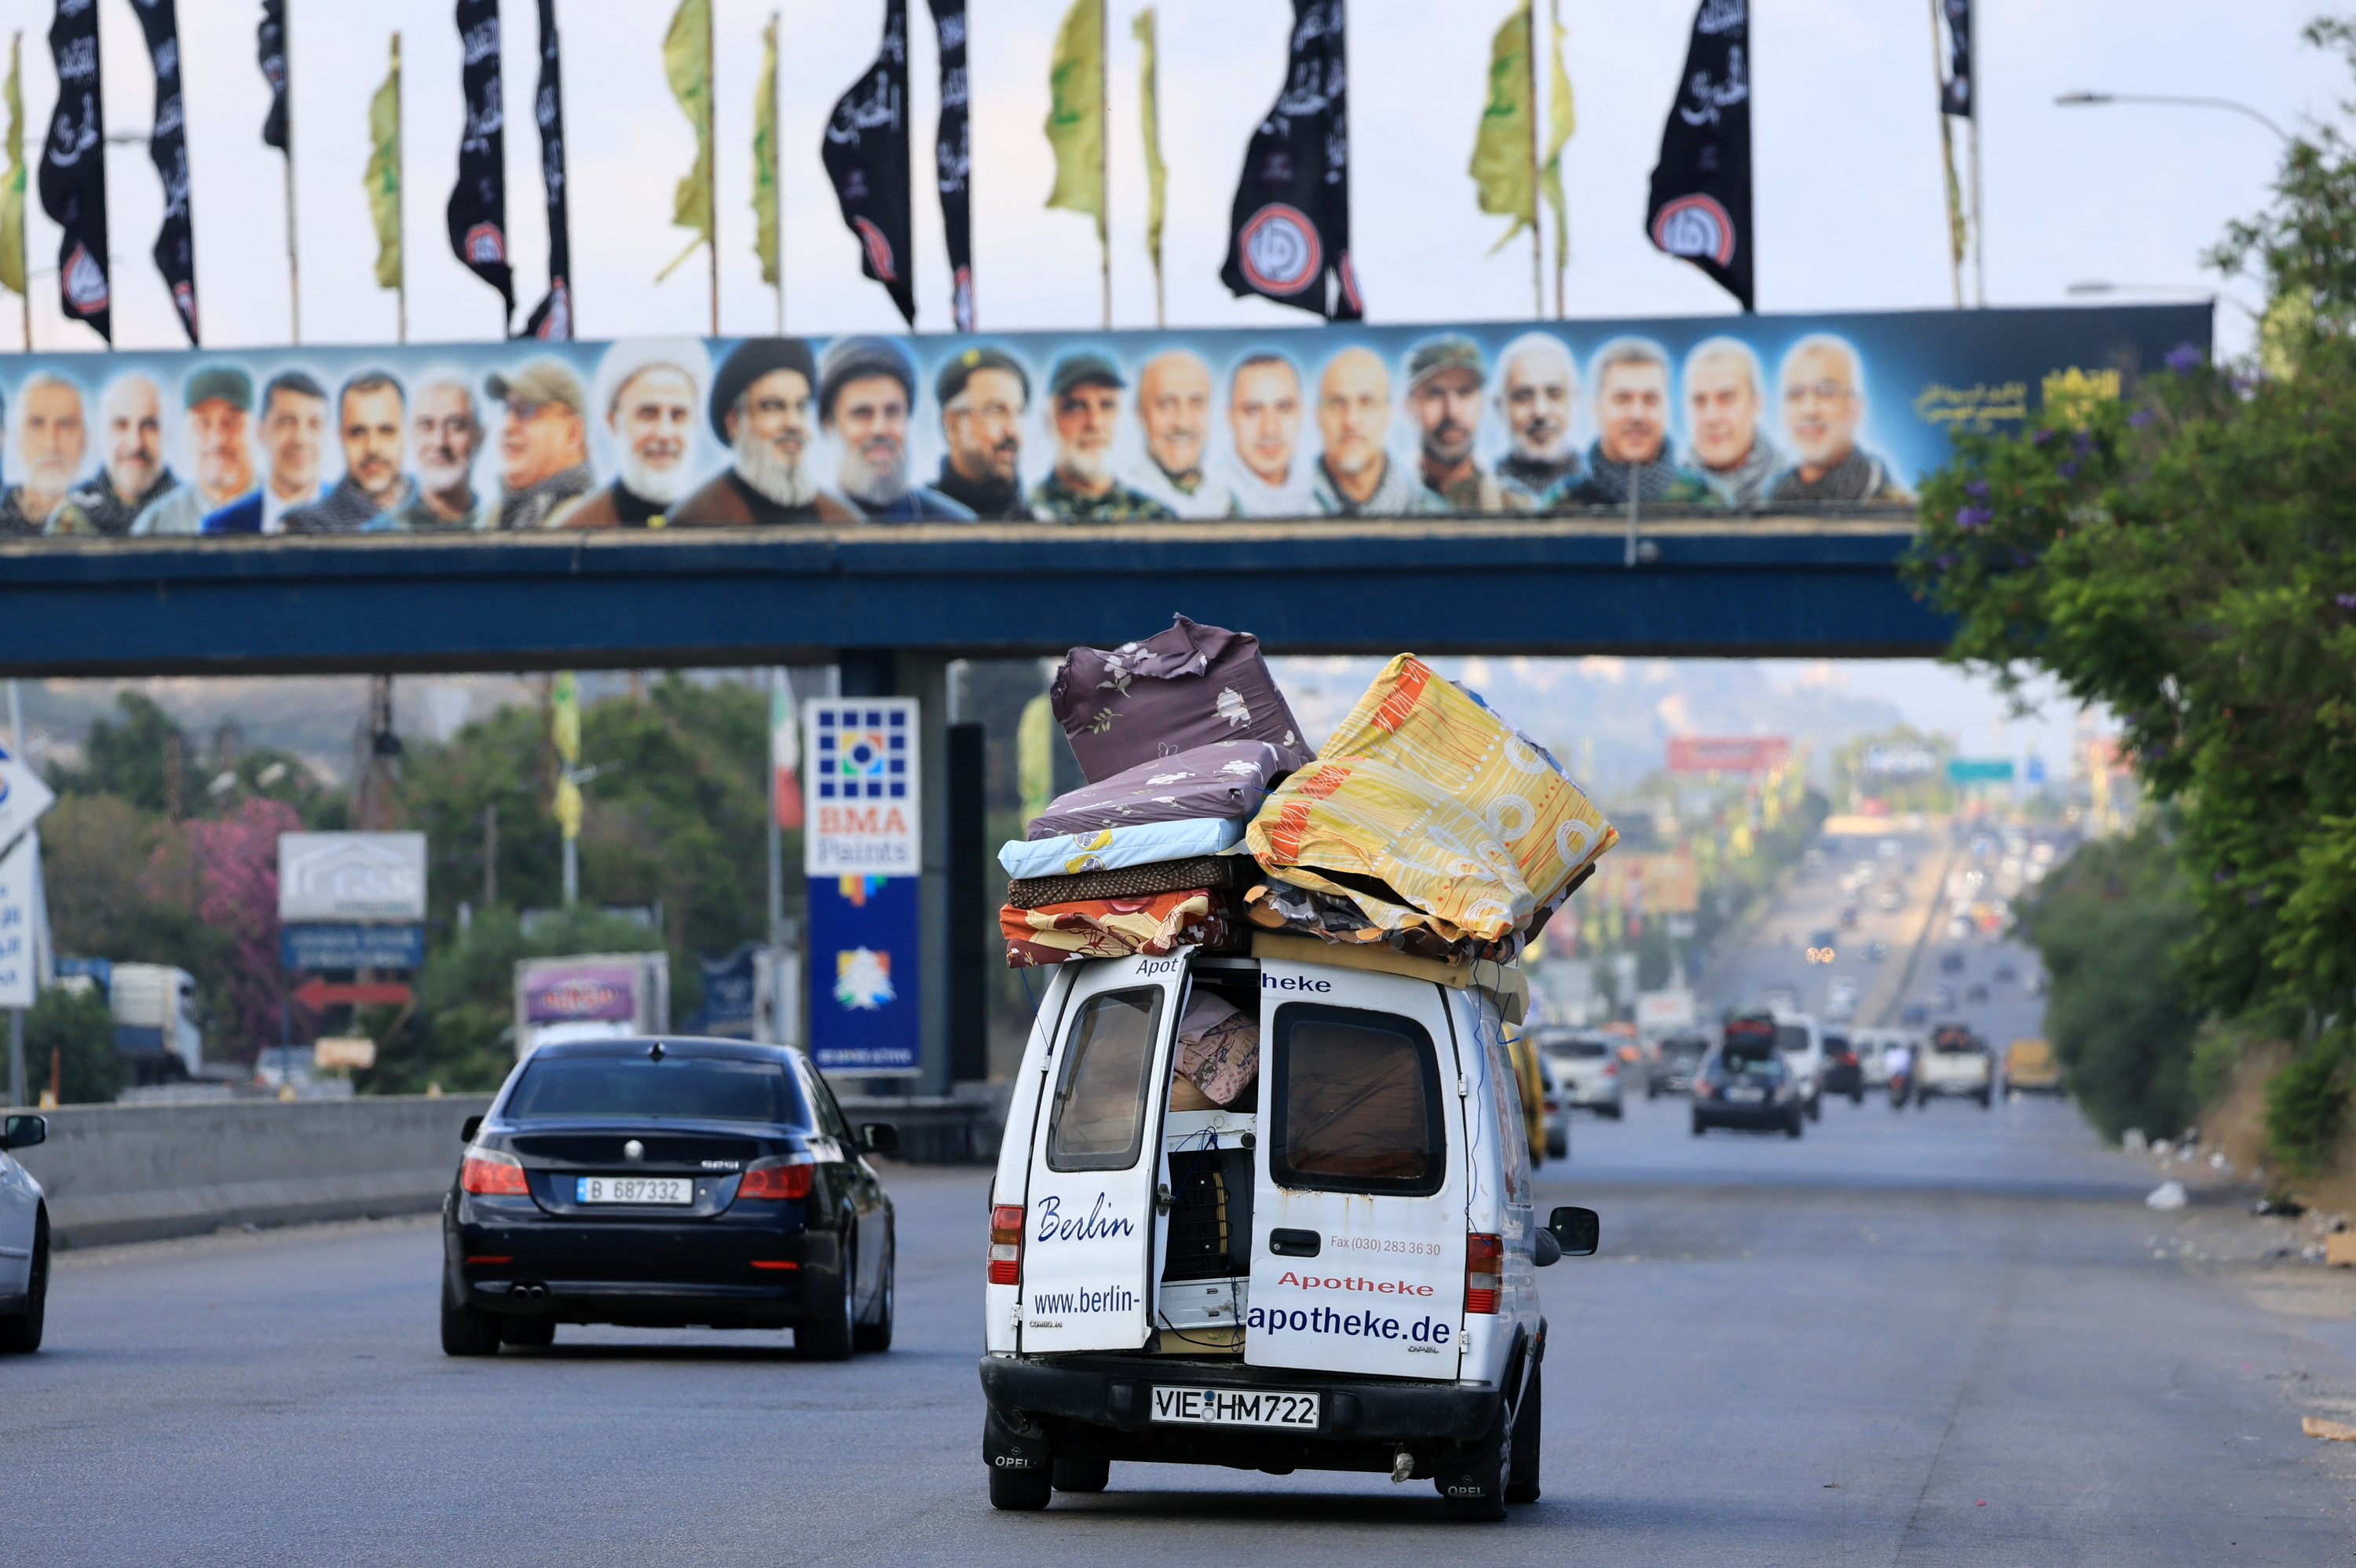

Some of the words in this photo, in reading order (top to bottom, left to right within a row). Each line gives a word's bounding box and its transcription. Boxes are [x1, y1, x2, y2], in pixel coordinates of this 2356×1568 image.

[819, 806, 908, 834] BMA
[818, 839, 909, 862] Paints
[1262, 972, 1332, 992] heke
[591, 1181, 602, 1199] B
[614, 1182, 679, 1200] 687332
[1038, 1191, 1134, 1242] Berlin
[1330, 1235, 1349, 1248] Fax
[1352, 1237, 1381, 1253] (030)
[1384, 1240, 1406, 1253] 283
[1409, 1241, 1423, 1254] 36
[1426, 1244, 1440, 1255] 30
[1278, 1271, 1434, 1296] Apotheke
[1034, 1285, 1140, 1314] www.berlin-
[1247, 1306, 1450, 1344] apotheke.de
[1407, 1345, 1439, 1354] OPEL
[1156, 1390, 1202, 1418] VIE
